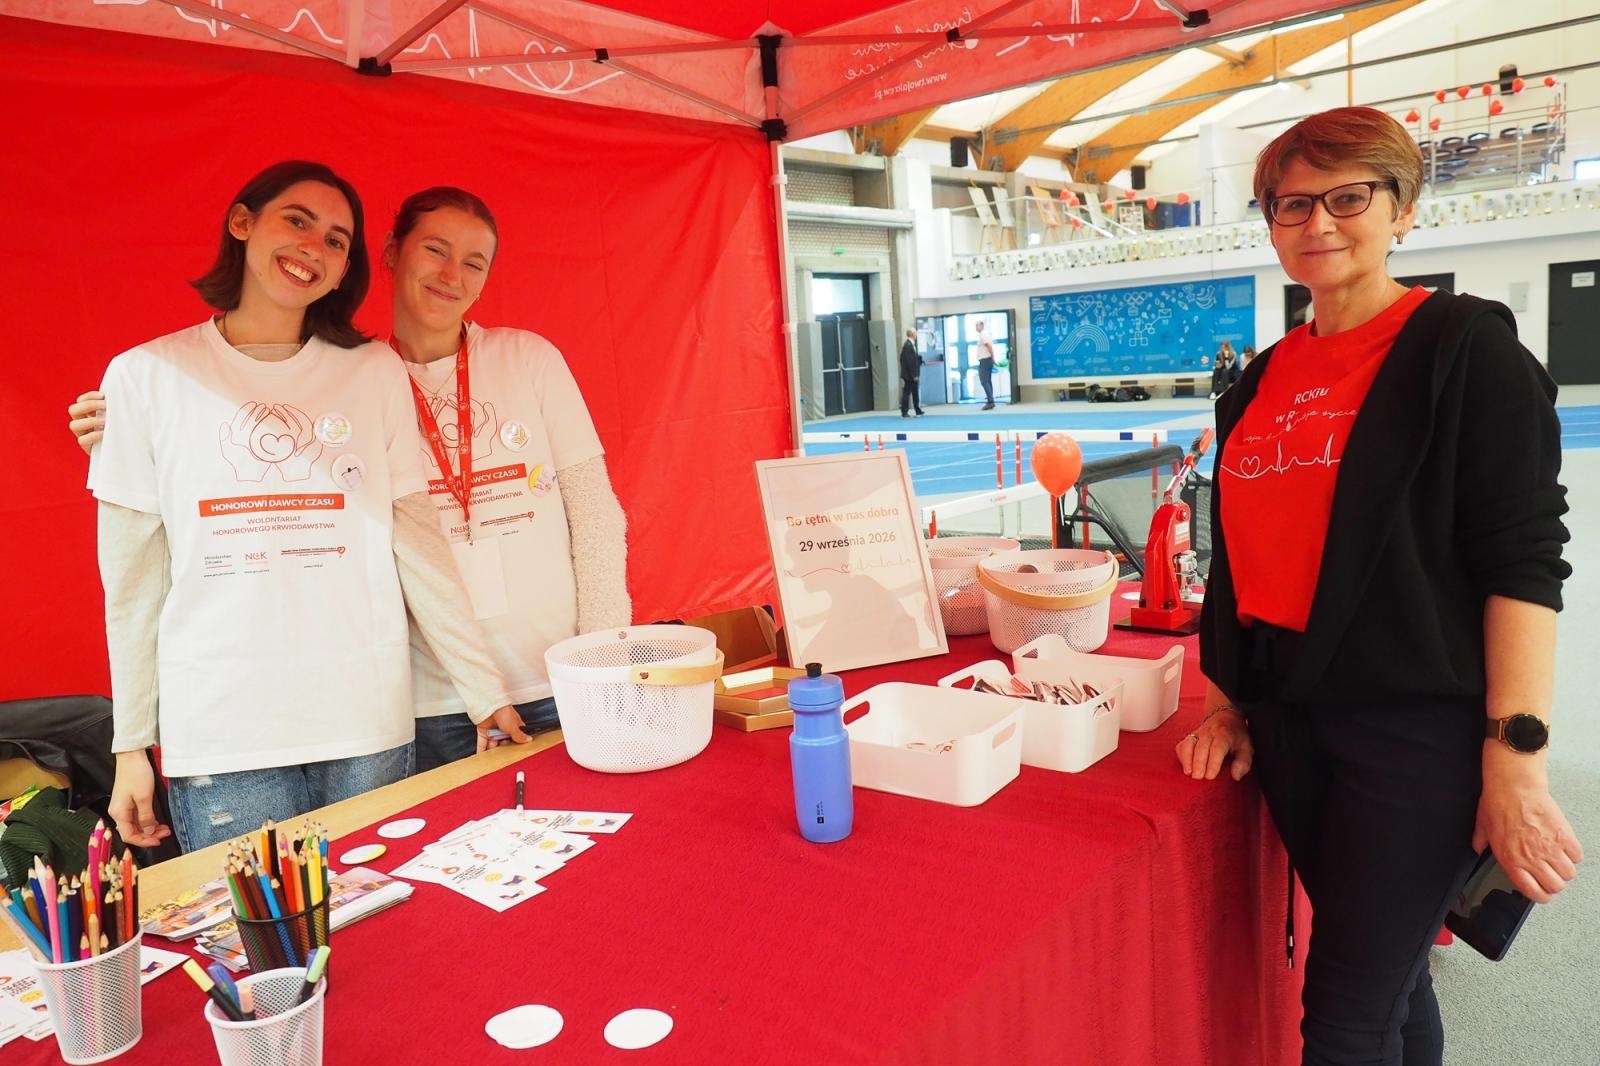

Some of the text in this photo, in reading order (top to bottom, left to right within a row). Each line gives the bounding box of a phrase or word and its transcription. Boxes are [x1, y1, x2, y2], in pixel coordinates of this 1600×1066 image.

[492, 469, 519, 480] CZASU
[211, 498, 335, 512] HONOROWI DAWCY CZASU
[247, 515, 302, 525] WOLONTARIAT
[785, 515, 802, 527] Bo
[833, 513, 843, 521] w
[846, 511, 865, 521] nas
[212, 523, 336, 536] HONOROWEGO KRWIODAWSTWA
[799, 531, 897, 552] 29 września 2026
